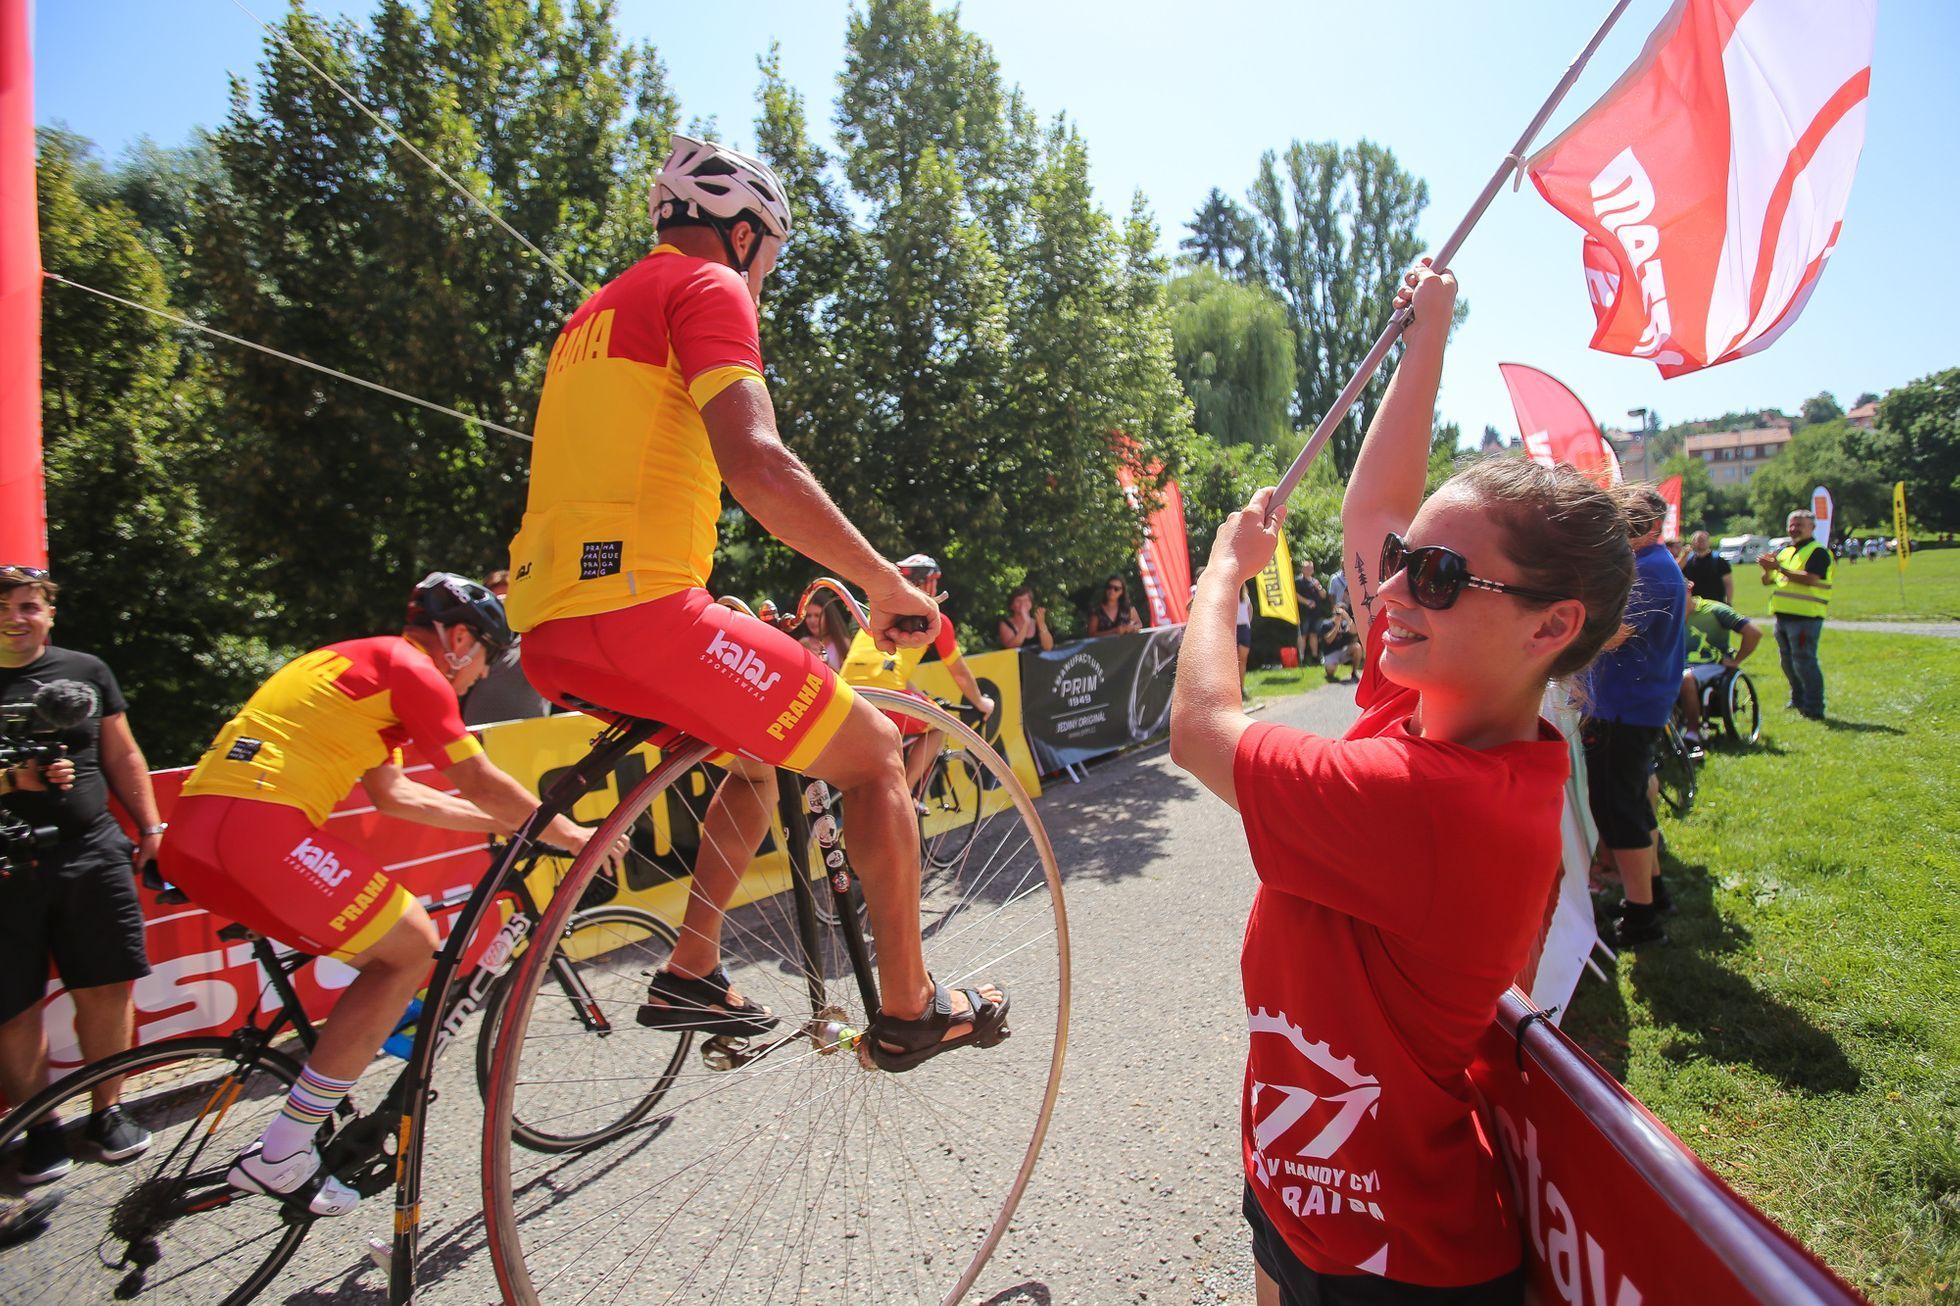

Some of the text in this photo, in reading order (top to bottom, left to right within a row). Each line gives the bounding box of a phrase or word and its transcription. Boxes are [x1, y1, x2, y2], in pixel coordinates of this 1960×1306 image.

[699, 654, 766, 702] SPORTSWEAR
[705, 628, 782, 692] kalas
[766, 672, 824, 742] PRAHA
[1060, 674, 1098, 698] PRIM
[1068, 693, 1092, 707] 1949
[290, 836, 352, 888] kalas
[329, 871, 390, 932] PRAHA
[501, 915, 527, 942] 25
[1285, 1160, 1346, 1187] HANDY
